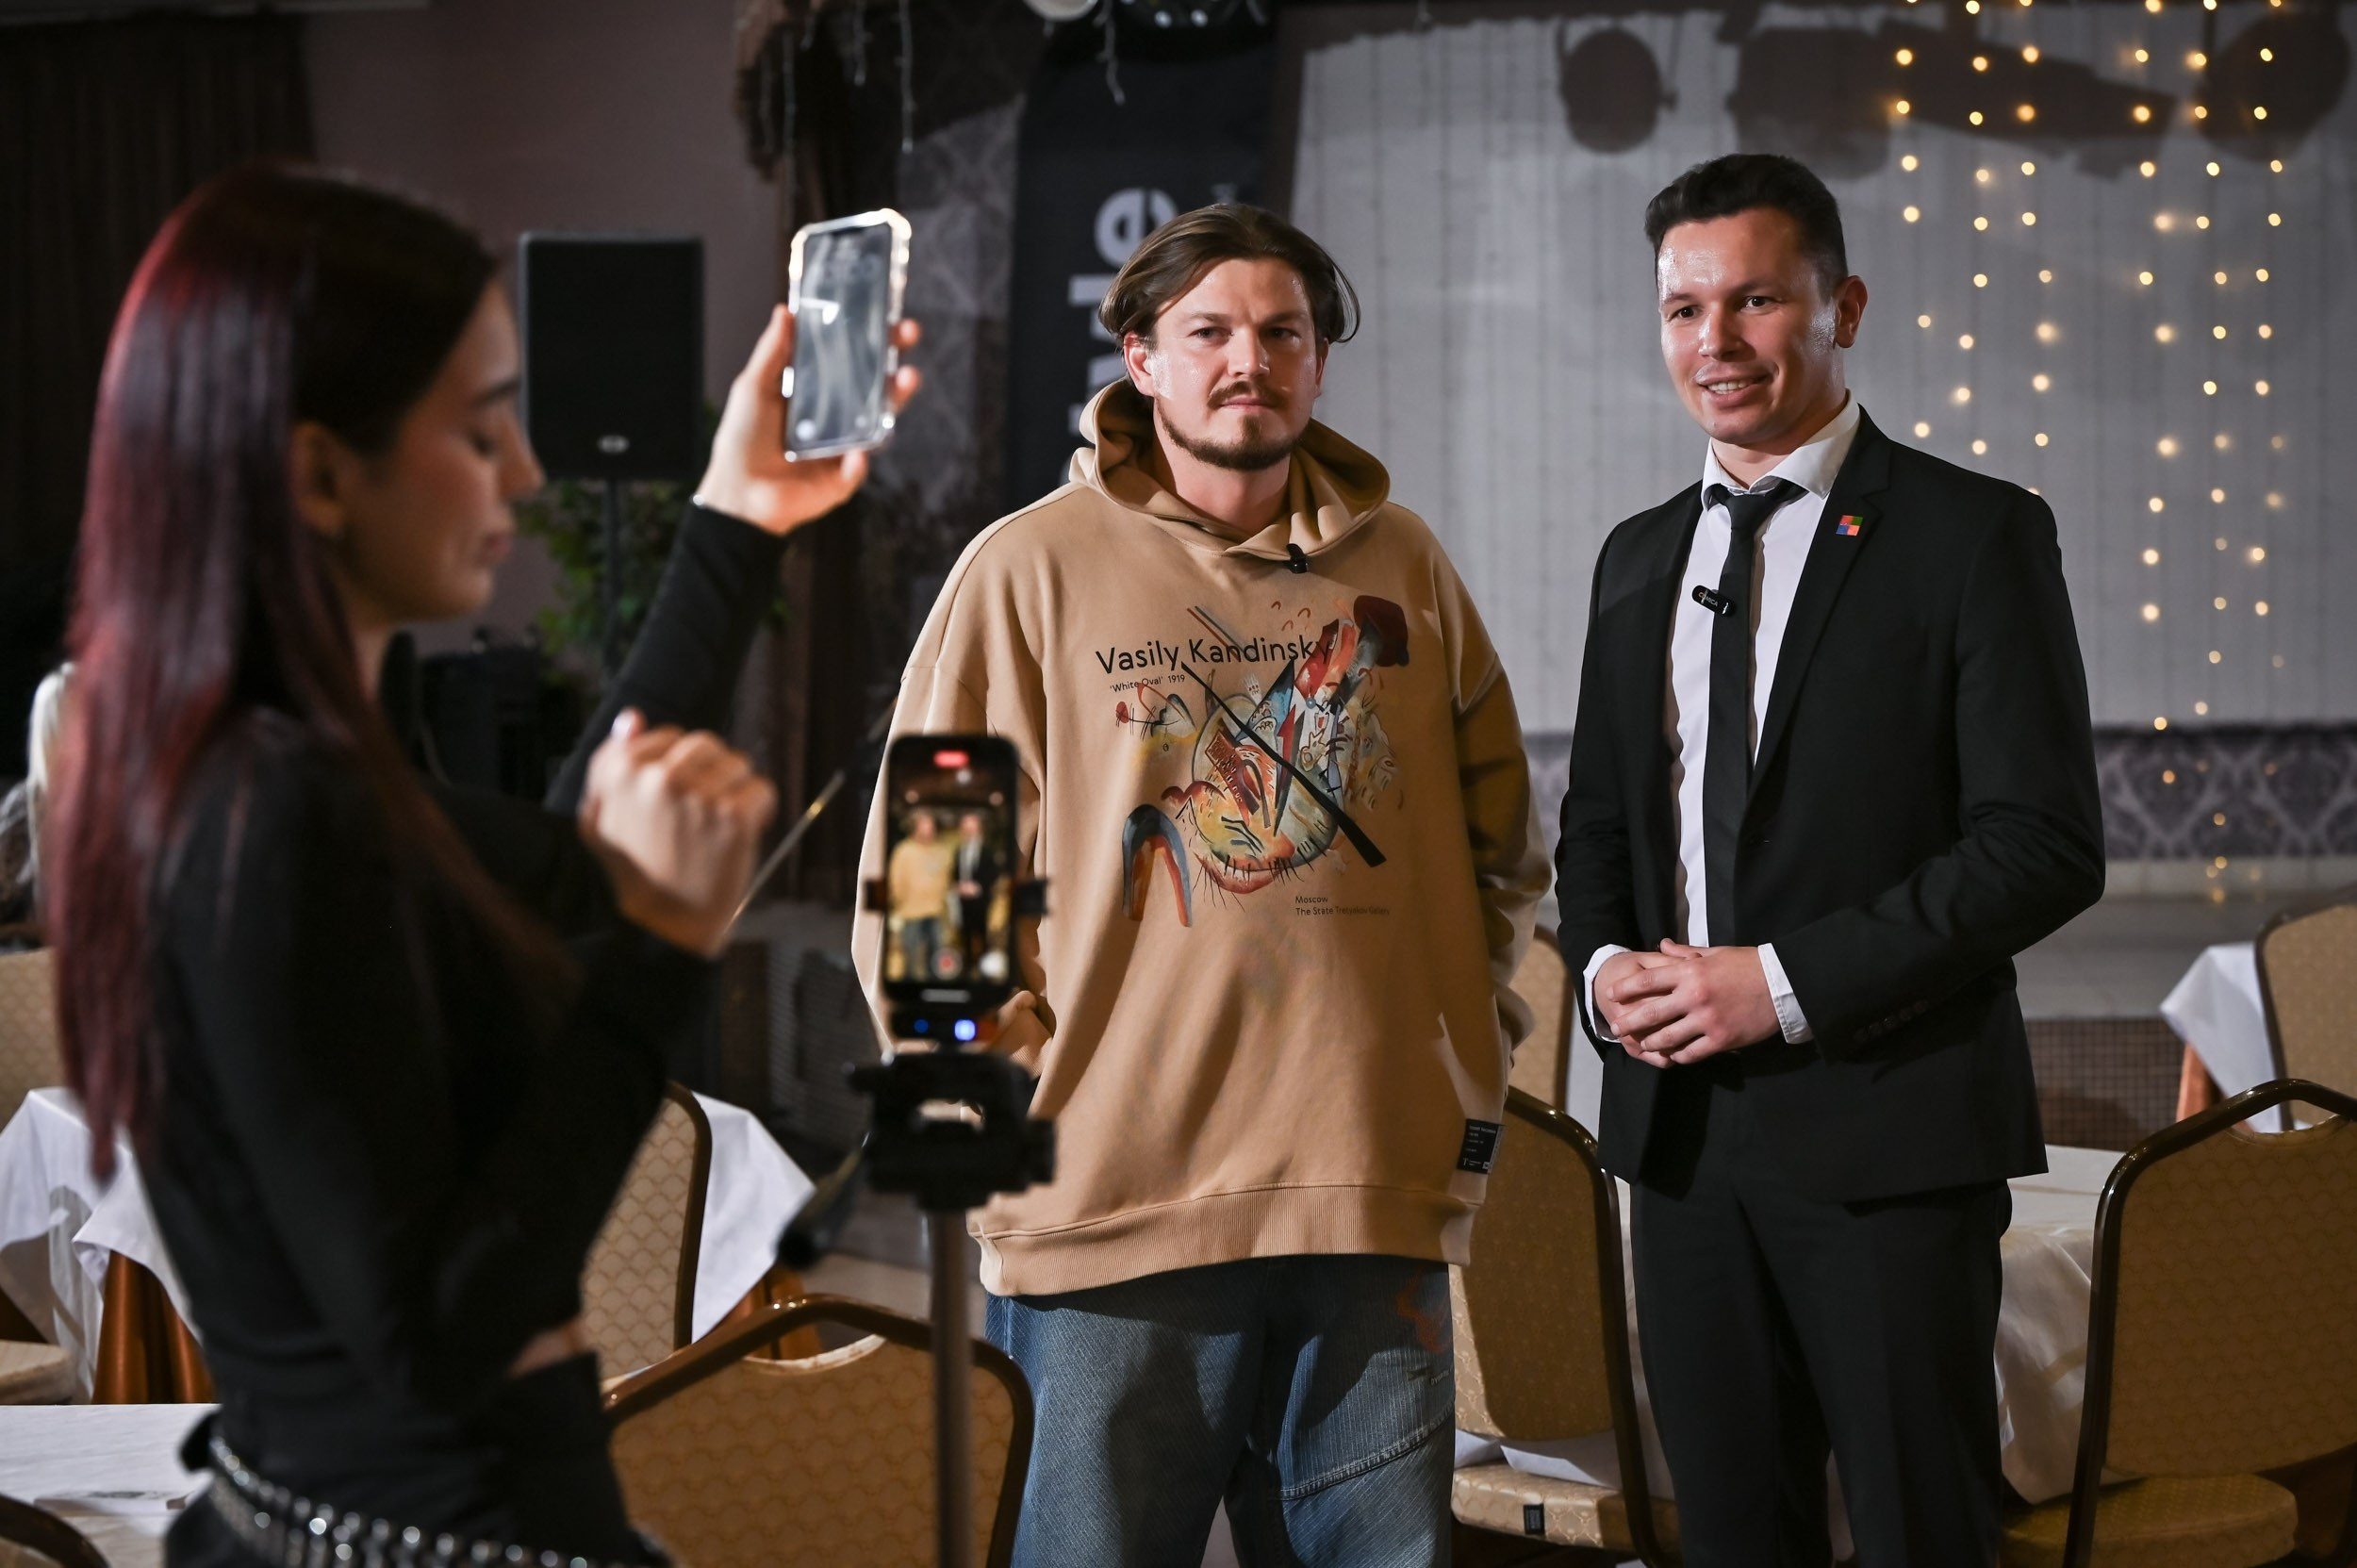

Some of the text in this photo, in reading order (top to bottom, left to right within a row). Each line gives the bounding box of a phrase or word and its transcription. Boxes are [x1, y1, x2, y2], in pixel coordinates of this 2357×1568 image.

[1095, 635, 1331, 674] Vasily Kandinsky
[1167, 674, 1186, 684] 1919
[1294, 895, 1328, 904] Moscow
[1295, 907, 1311, 916] The
[1312, 906, 1334, 916] State
